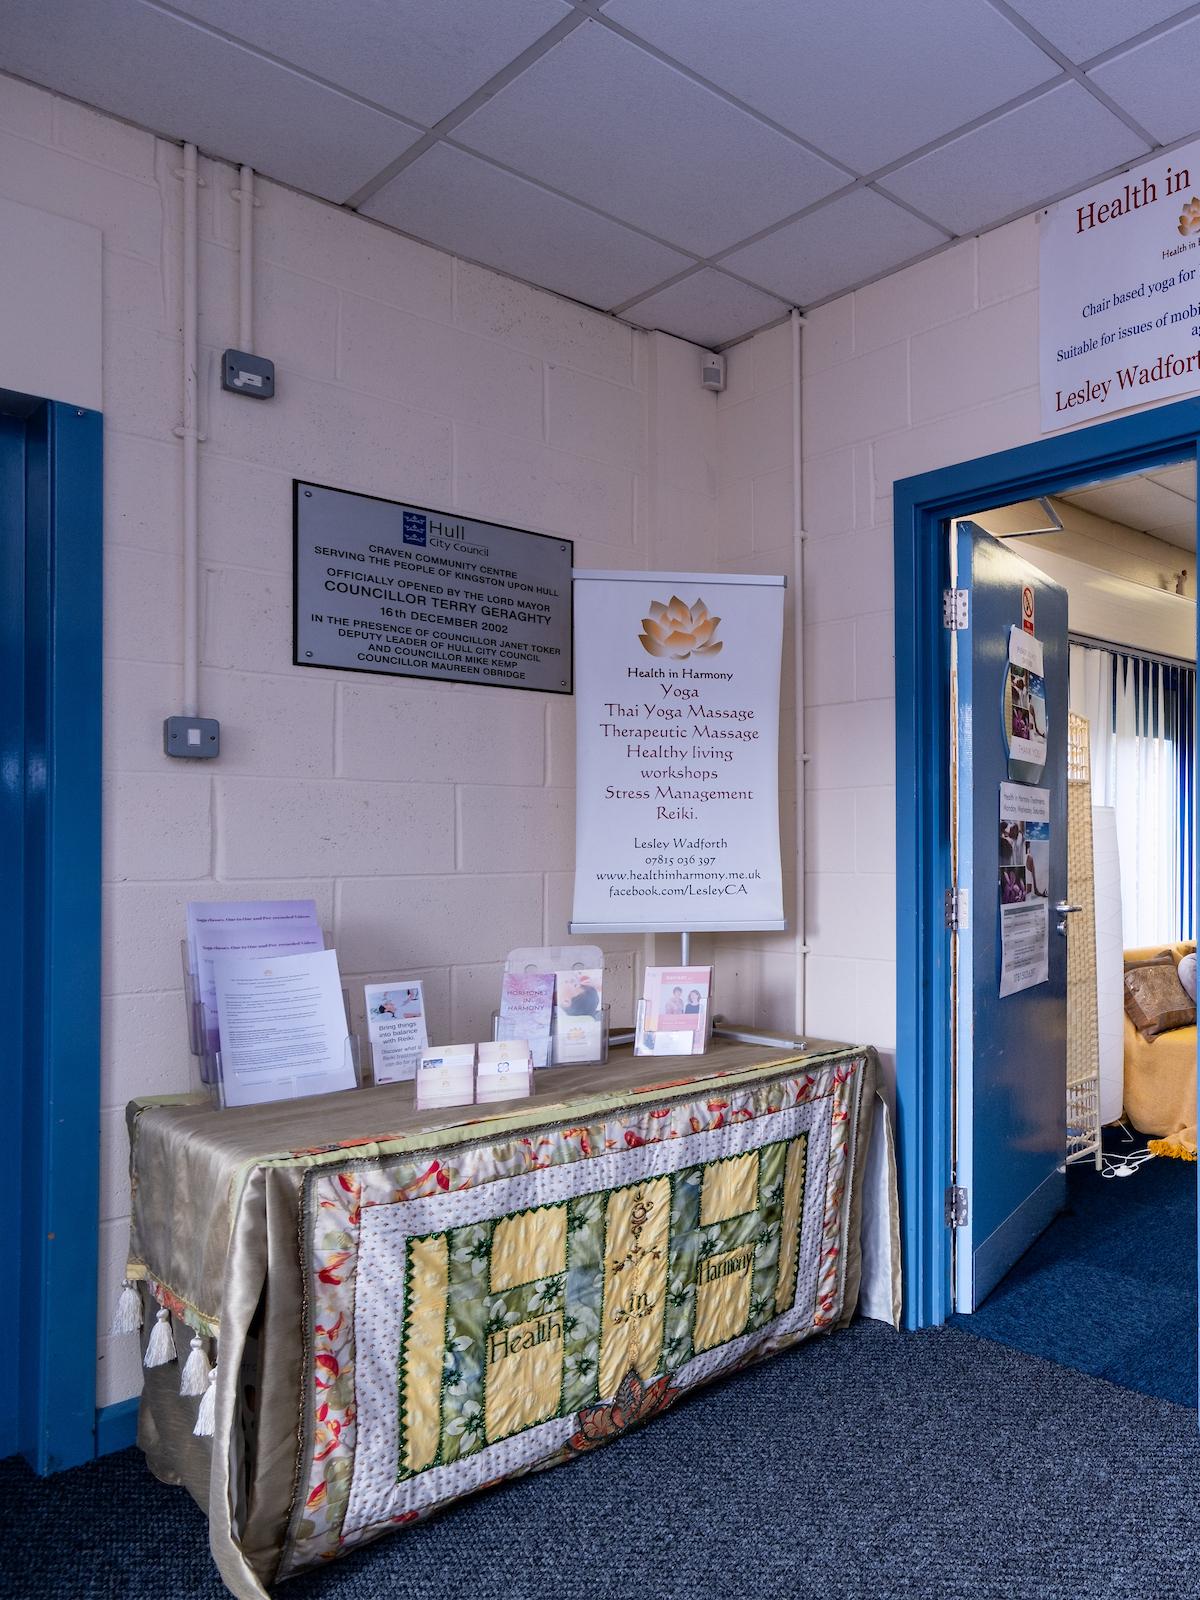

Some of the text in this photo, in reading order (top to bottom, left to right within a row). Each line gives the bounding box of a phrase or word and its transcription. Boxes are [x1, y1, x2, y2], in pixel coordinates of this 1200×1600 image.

[1076, 176, 1157, 234] Health
[1166, 167, 1191, 196] in
[1082, 298, 1111, 318] Chair
[1113, 283, 1145, 307] based
[1148, 277, 1175, 298] yoga
[1179, 268, 1196, 284] for
[1056, 338, 1098, 362] Suitable
[1101, 330, 1116, 347] for
[1118, 322, 1153, 340] issues
[1155, 312, 1168, 328] of
[1055, 379, 1112, 412] Lesley
[429, 520, 465, 541] Hull
[429, 537, 489, 557] City Council
[314, 546, 559, 597] SERVING THE PEOPLE OF KINGSTON UPON HULL
[369, 544, 518, 580] CRAVEN COMMUNITY CENTRE
[327, 567, 551, 613] OFFICIALLY OPENED BY THE LORD MAYOR
[324, 580, 552, 626] COUNCILLOR TERRY GERAGHTY
[380, 607, 508, 634] 16th DECEMBER 2002
[357, 652, 526, 680] COUNCILLOR MAUREEN OBRIDGE
[368, 643, 518, 669] AND COUNCILLOR MIKE KEMP
[627, 667, 734, 682] Health in Harmony
[660, 683, 699, 700] Yoga
[604, 703, 755, 722] Thai Yoga Massage
[600, 723, 759, 742] Therapeutic Massage
[627, 744, 734, 762] Healthy living
[640, 765, 718, 781] workshops
[604, 785, 754, 802] Stress Management
[656, 806, 698, 820] Reiki.
[634, 837, 728, 850] Lesley Wadforth
[645, 854, 716, 866] 07815 036 397
[596, 869, 761, 881] www.healthinharmony.me.uk
[609, 884, 748, 898] facebook.com/LesleyCA
[699, 1252, 754, 1289] Harmony
[627, 1291, 648, 1313] in
[489, 1318, 562, 1363] Health
